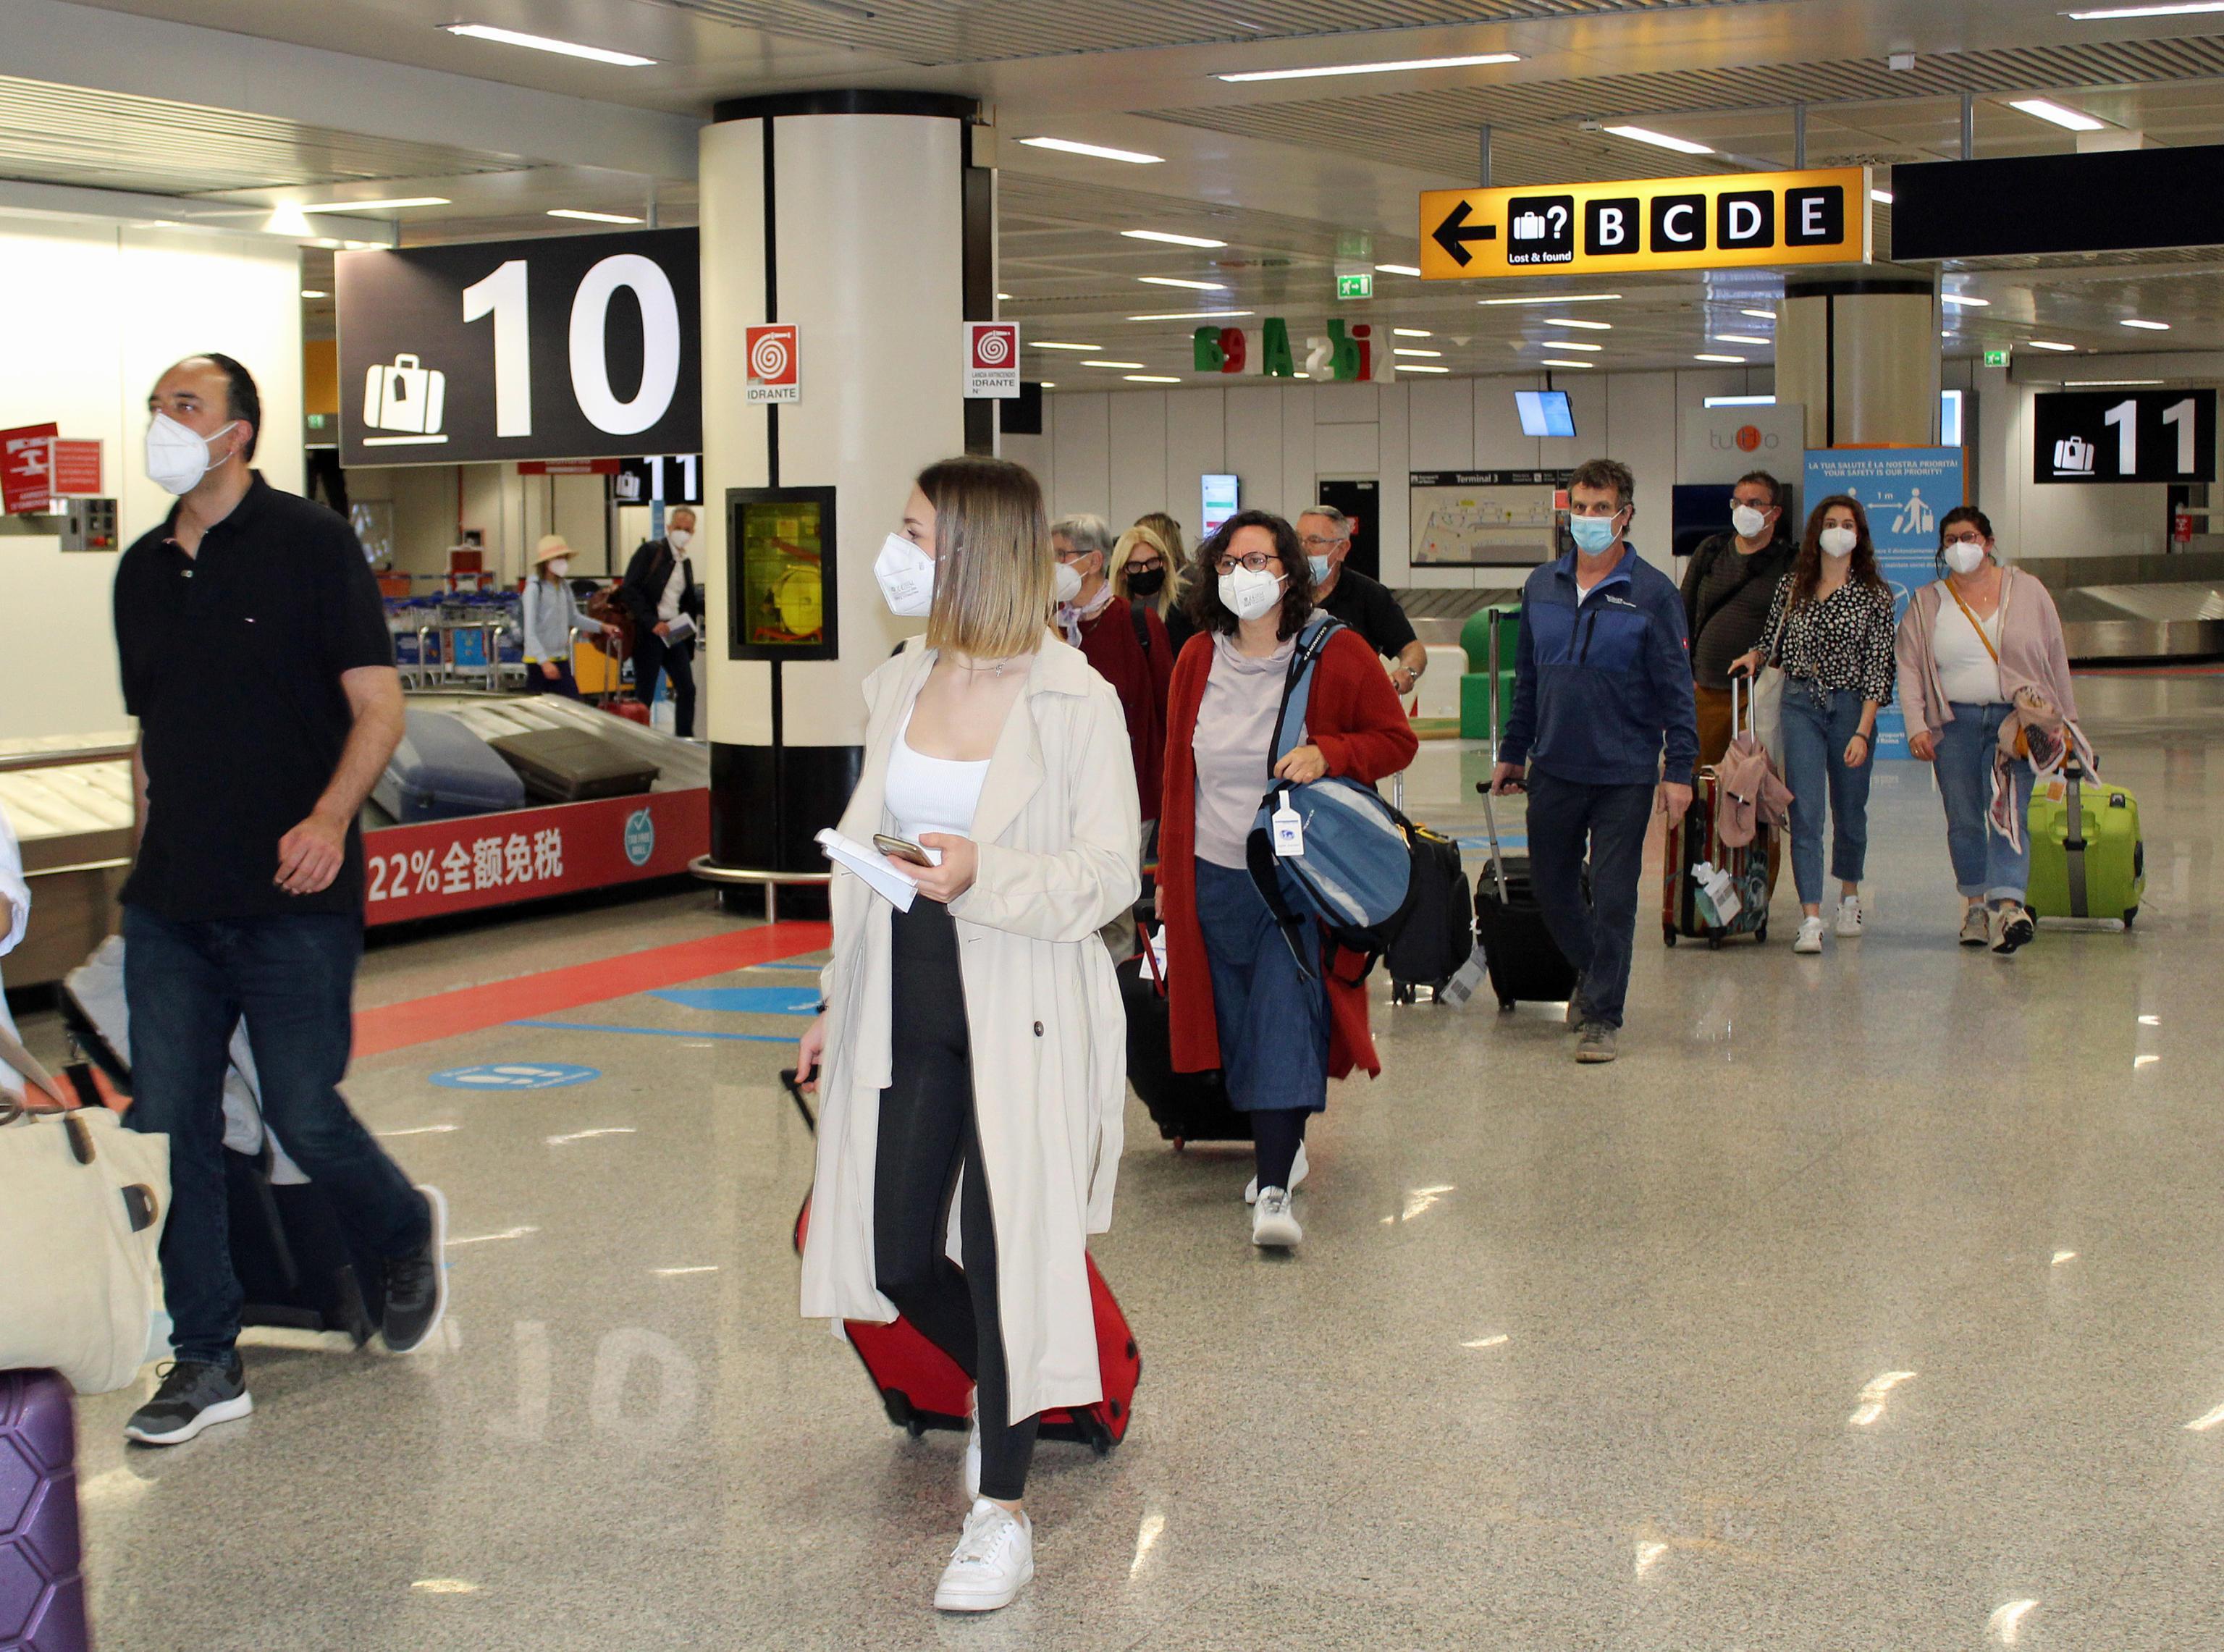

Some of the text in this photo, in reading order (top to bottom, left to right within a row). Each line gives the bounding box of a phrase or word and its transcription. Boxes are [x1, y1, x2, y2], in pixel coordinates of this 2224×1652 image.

[1599, 197, 1826, 245] B C D E
[1509, 250, 1572, 264] Lost & found
[463, 253, 681, 437] 10
[747, 387, 796, 400] IDRANTE
[2105, 398, 2195, 475] 11
[643, 455, 697, 501] 11
[1455, 473, 1499, 483] Terminal 3
[368, 827, 564, 902] 22%全额免税
